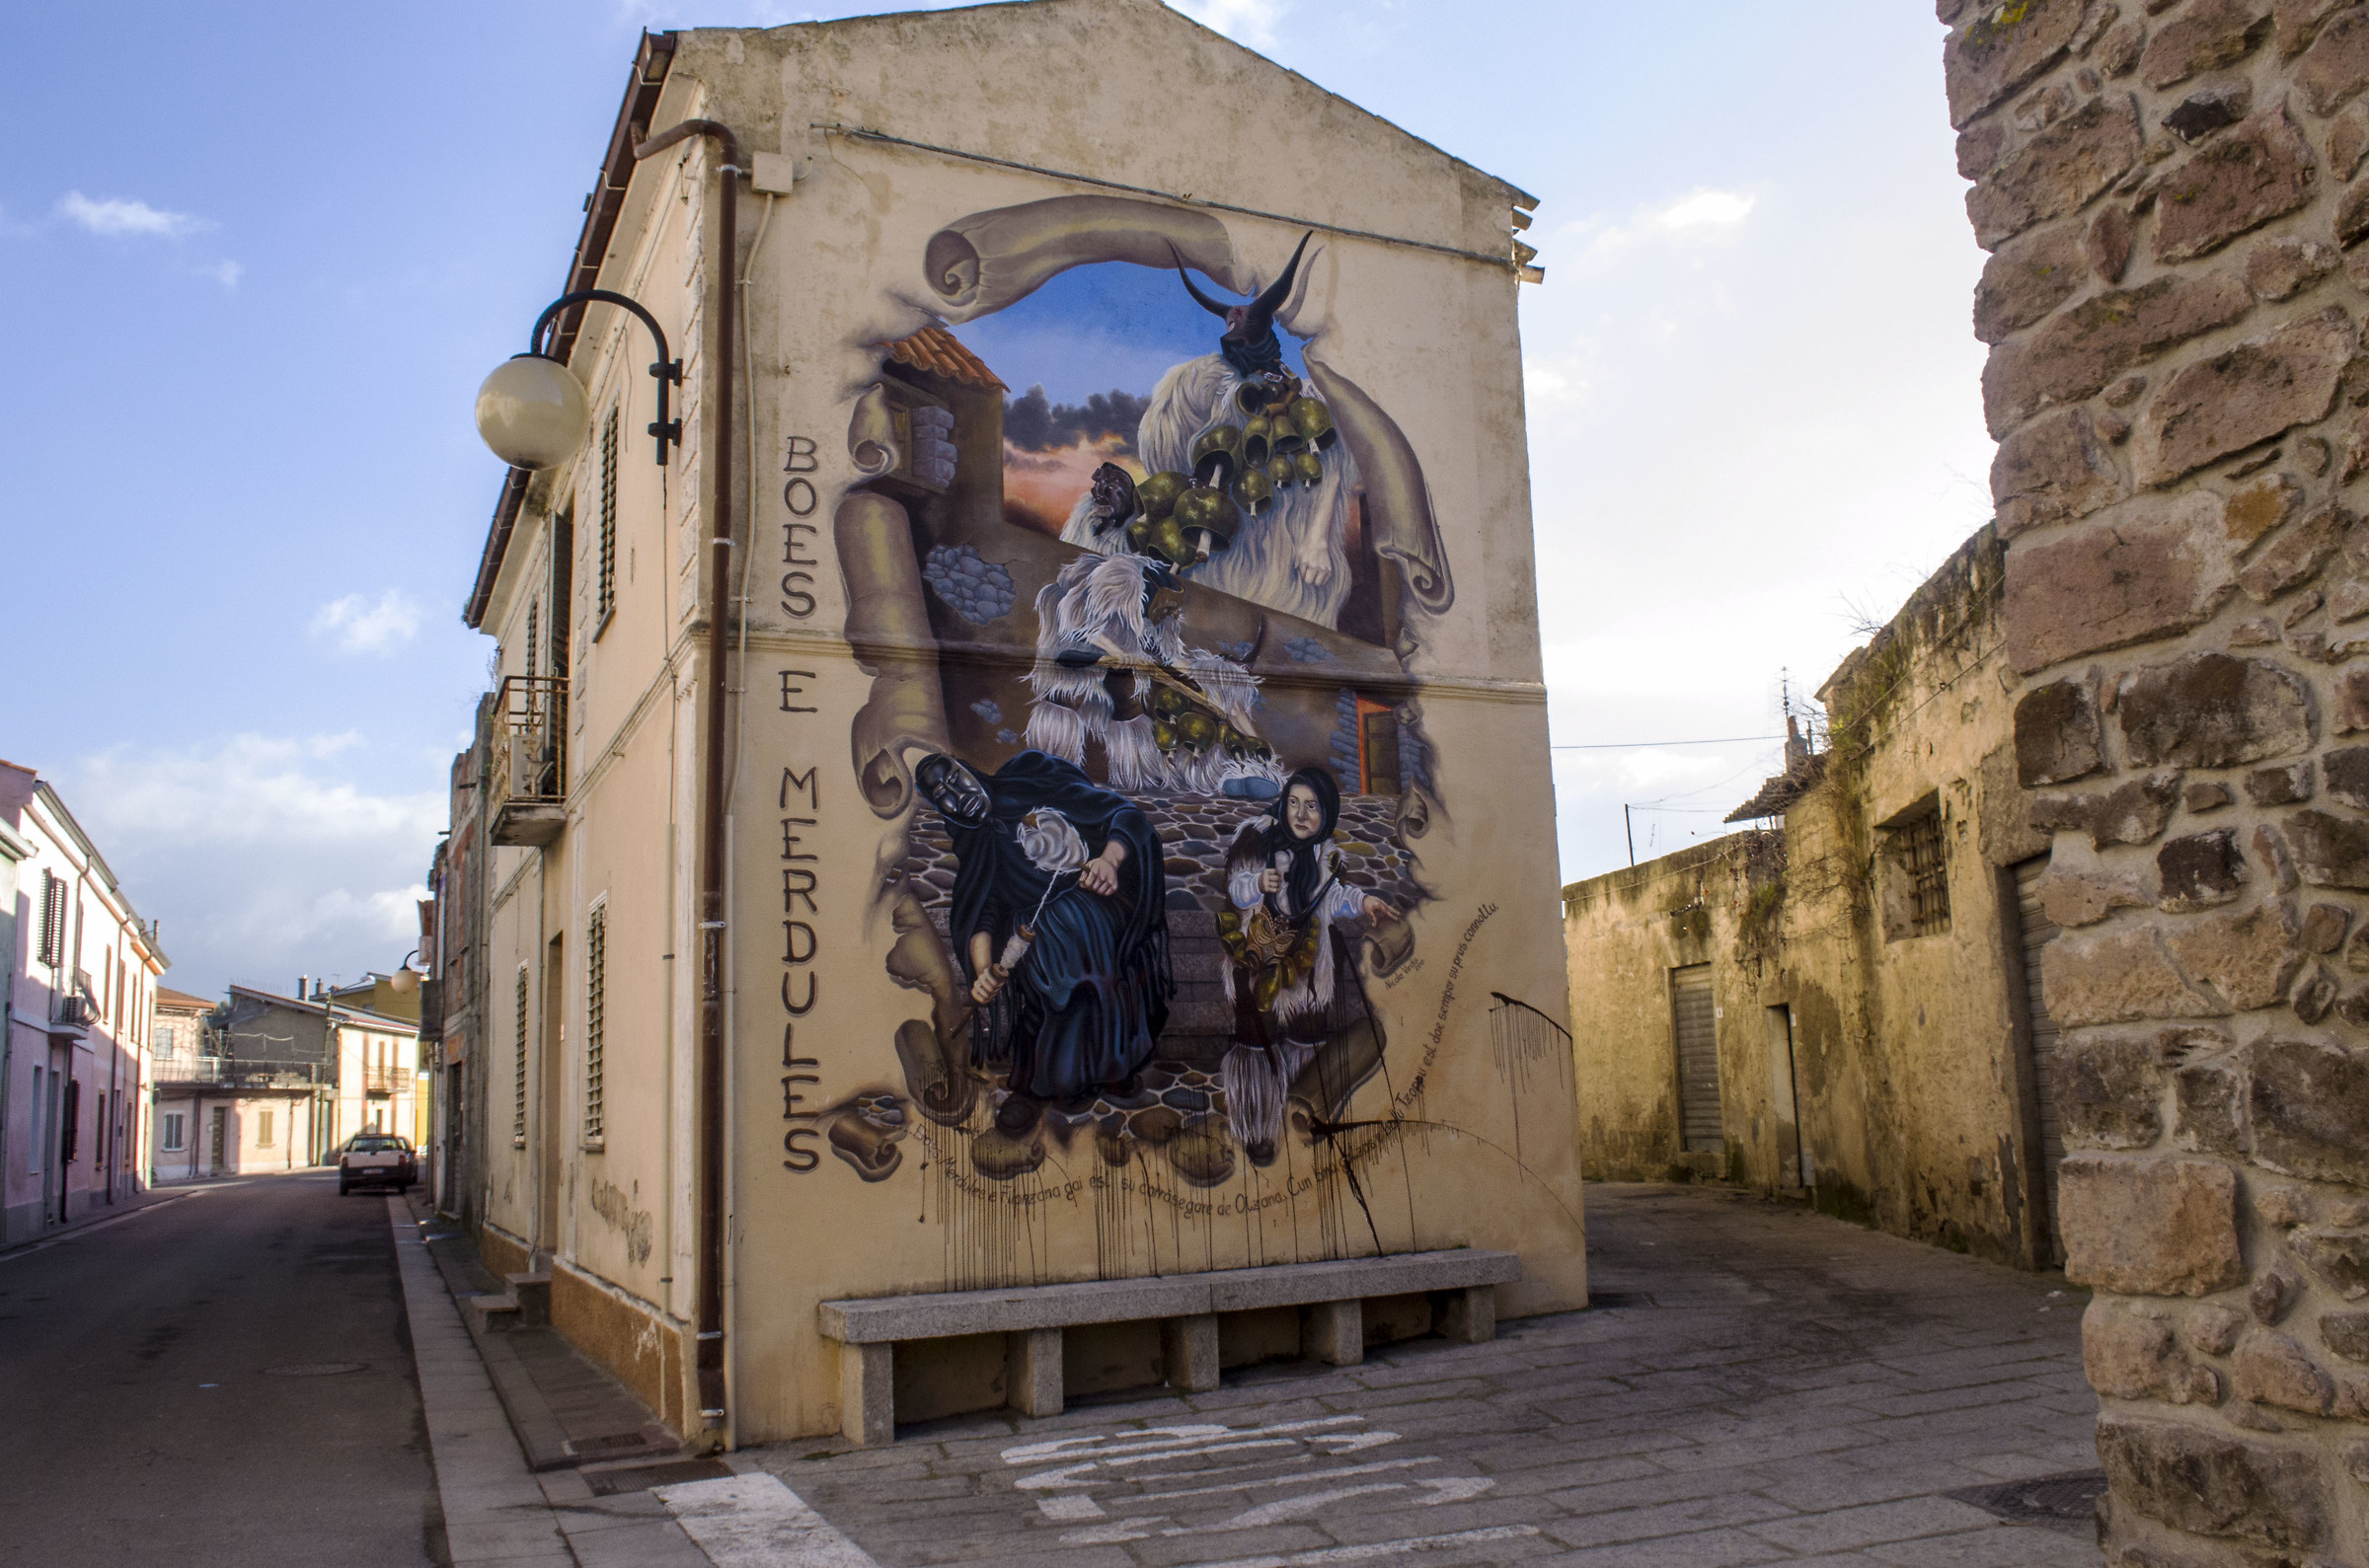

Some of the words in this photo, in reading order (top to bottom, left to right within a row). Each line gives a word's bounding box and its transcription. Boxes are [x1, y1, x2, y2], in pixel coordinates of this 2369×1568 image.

[782, 435, 818, 618] BOES
[778, 669, 818, 713] E
[779, 766, 820, 1172] MERDULES
[1217, 1192, 1232, 1217] de
[1286, 1174, 1313, 1197] Cun
[1422, 1042, 1438, 1067] est
